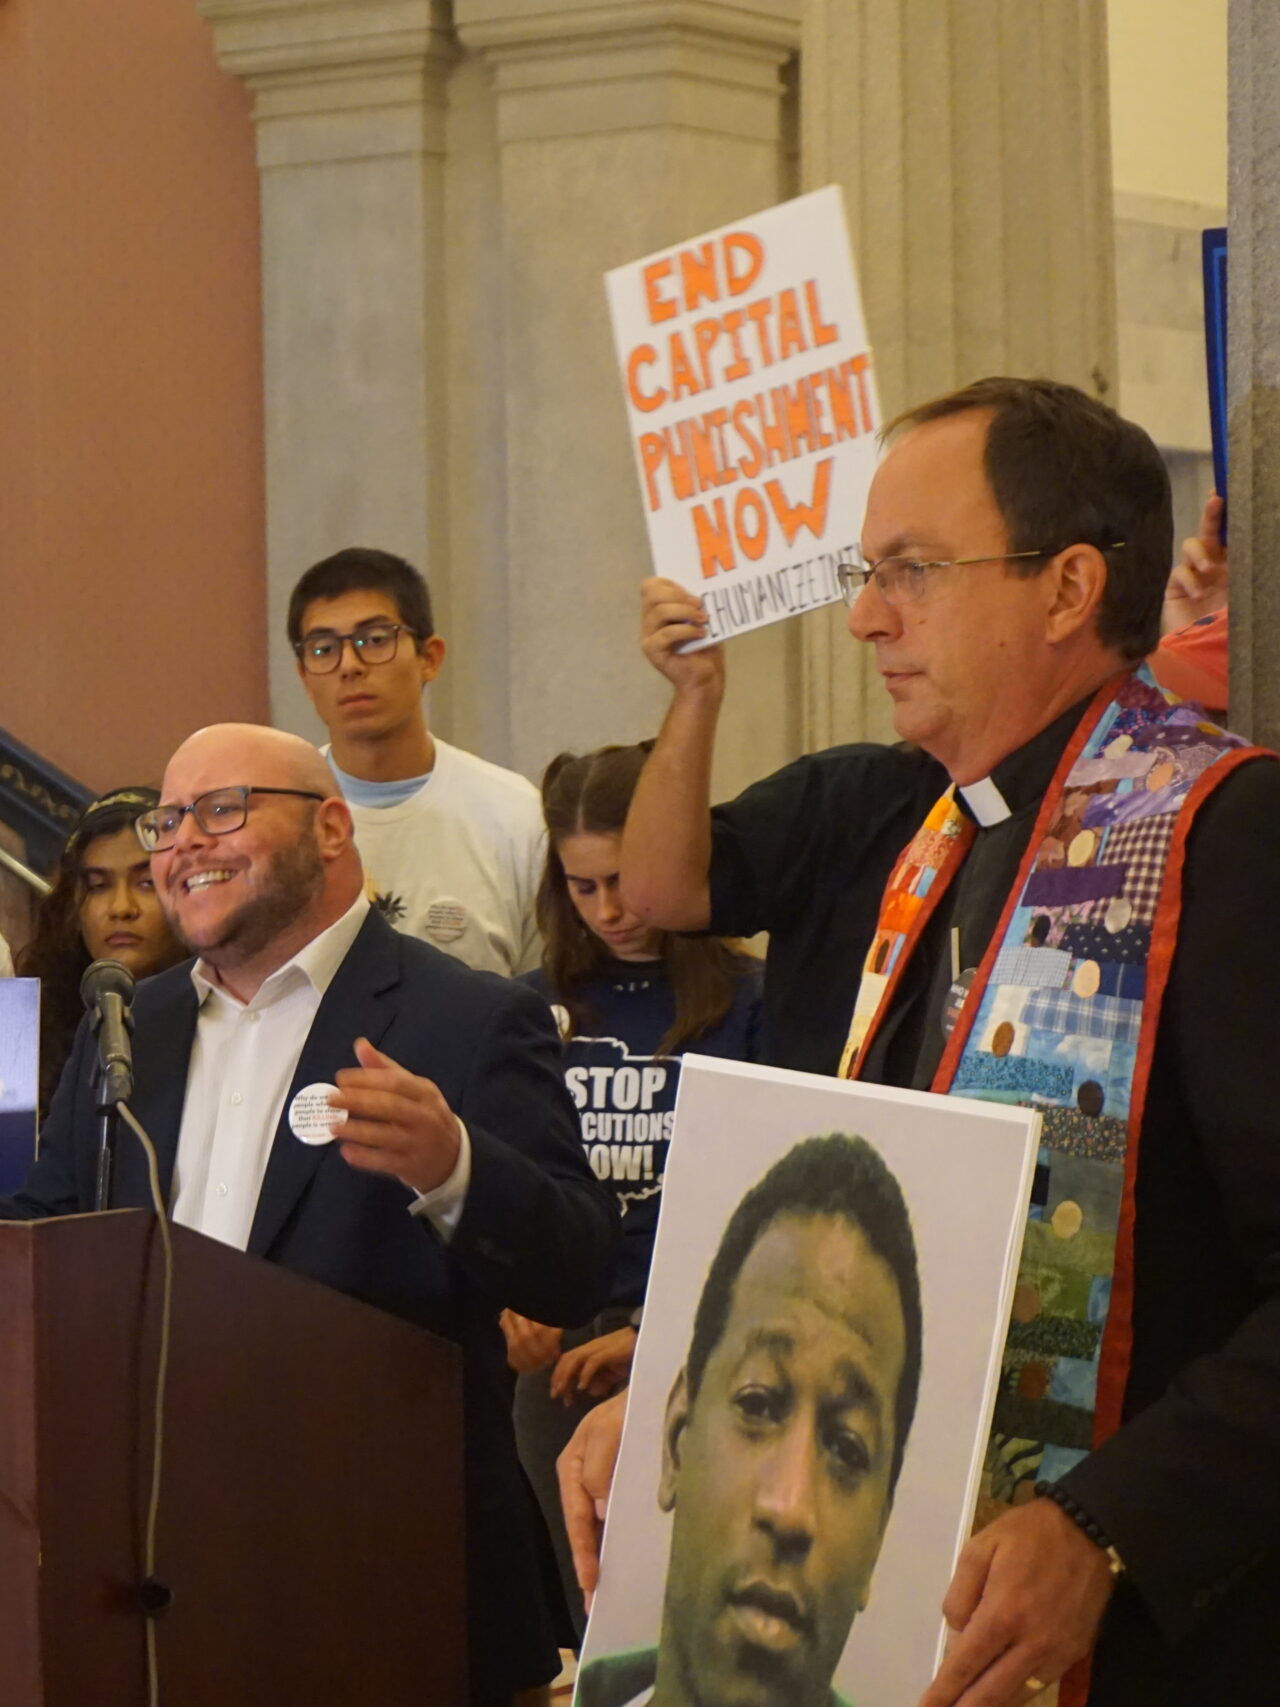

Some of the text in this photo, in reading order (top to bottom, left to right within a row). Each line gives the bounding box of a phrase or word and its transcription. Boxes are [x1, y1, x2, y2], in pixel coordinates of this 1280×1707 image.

[641, 231, 765, 325] END
[627, 279, 839, 413] CAPITAL
[639, 354, 873, 512] PUNISHMENT
[691, 457, 835, 579] NOW
[564, 1066, 667, 1111] STOP
[579, 1110, 675, 1142] CUTIONS
[582, 1143, 654, 1180] OW!
